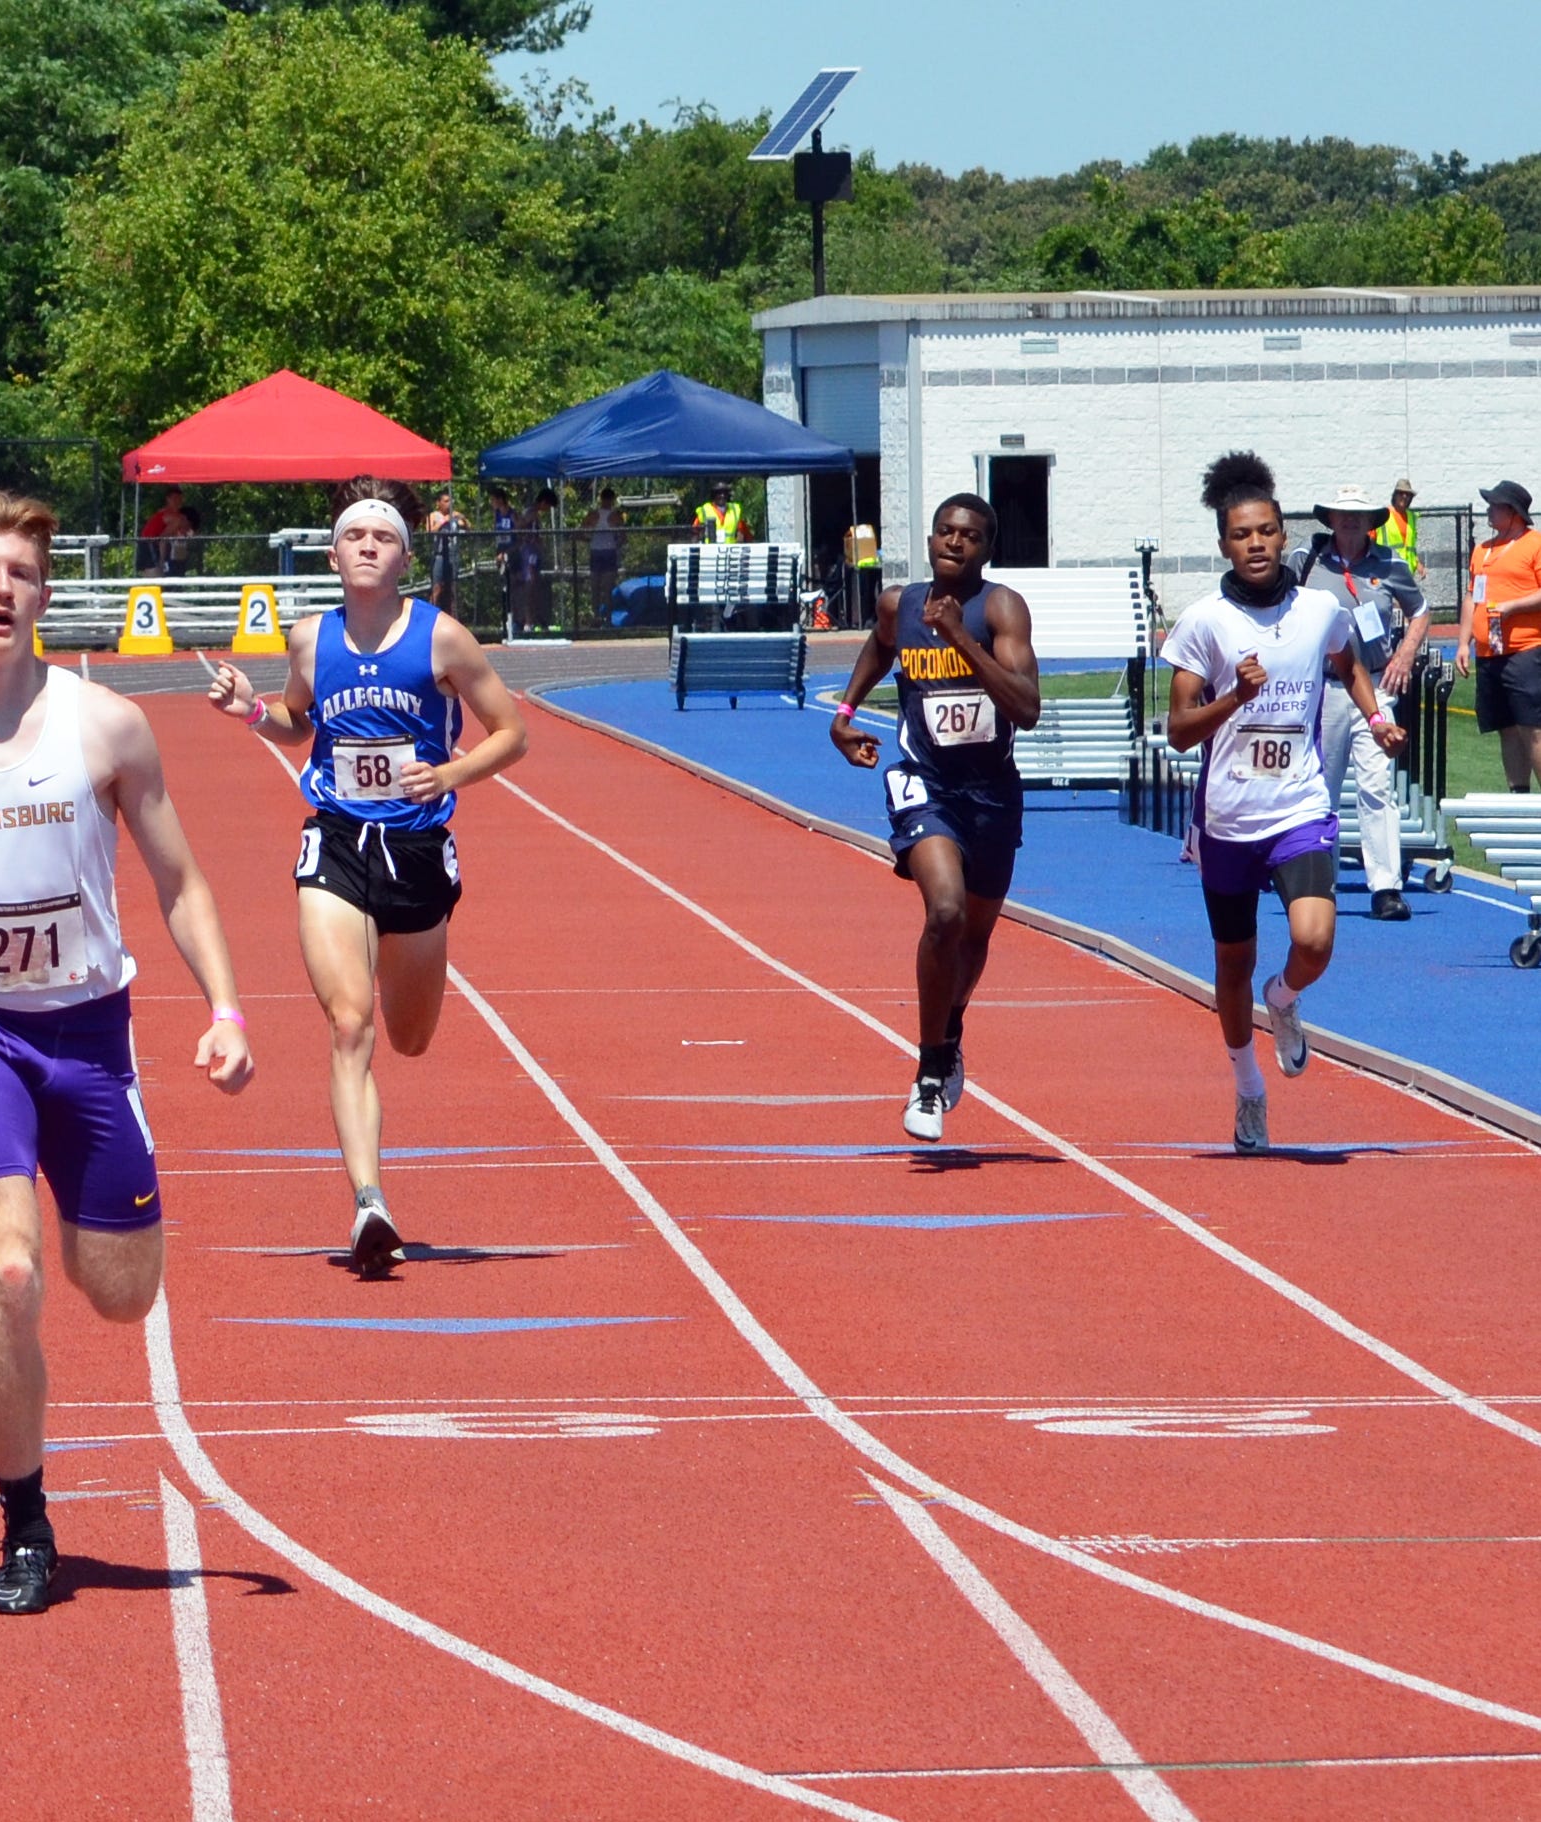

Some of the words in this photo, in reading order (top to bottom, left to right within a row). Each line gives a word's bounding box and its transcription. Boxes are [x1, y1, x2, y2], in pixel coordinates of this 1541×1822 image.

[136, 601, 154, 629] 3
[250, 600, 267, 627] 2
[322, 686, 423, 723] ALLEGANY
[935, 702, 982, 734] 267
[1243, 701, 1307, 714] RAIDERS
[1250, 738, 1292, 770] 188
[356, 754, 392, 788] 58
[899, 773, 915, 802] 2
